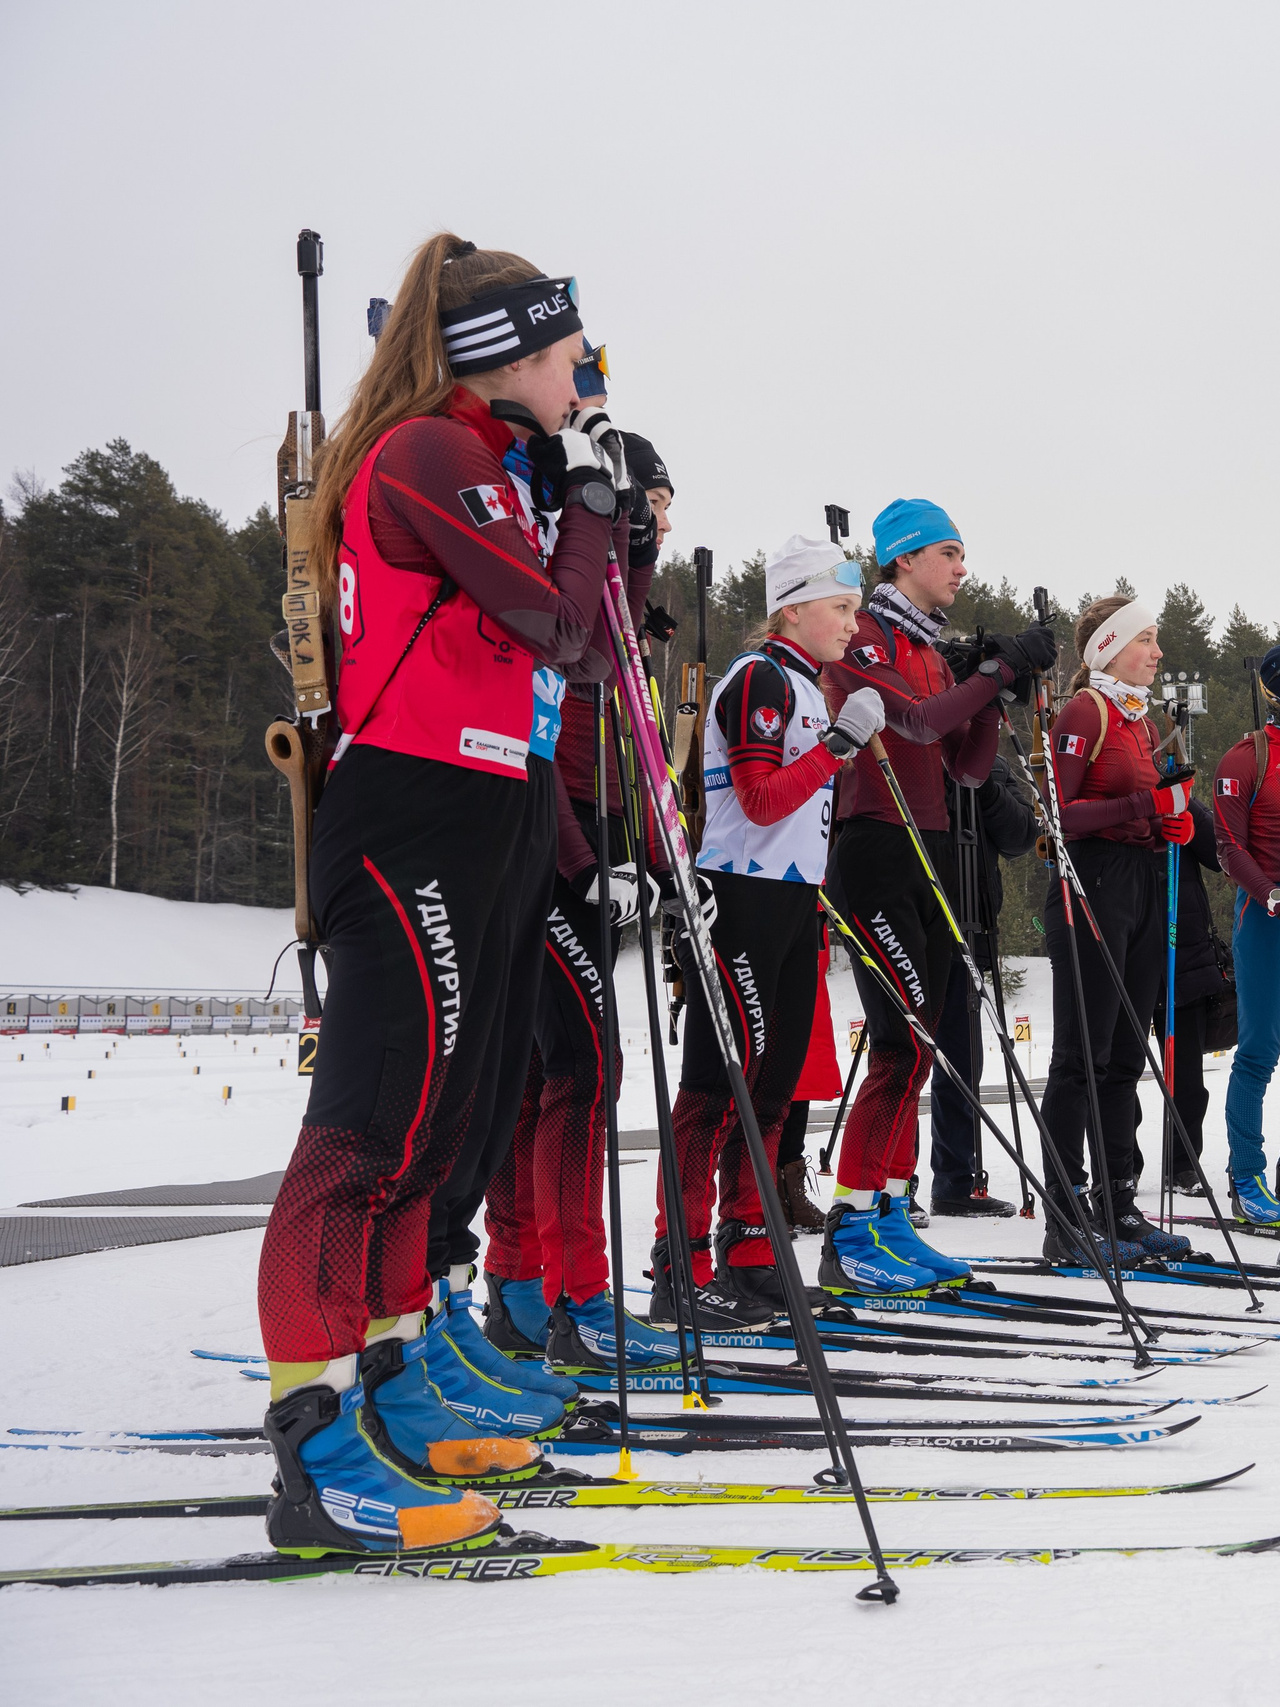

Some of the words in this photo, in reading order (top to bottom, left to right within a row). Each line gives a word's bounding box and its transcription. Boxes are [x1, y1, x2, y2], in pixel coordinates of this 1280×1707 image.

[527, 293, 569, 325] RUS
[631, 530, 654, 546] EKI
[886, 531, 921, 551] NORDSKI
[415, 879, 461, 1056] УДМУРТИЯ
[547, 906, 604, 1017] УДМУРТ
[871, 911, 925, 1007] УДМУРТИЯ
[733, 951, 765, 1056] УДМУРТИЯ
[1016, 1024, 1030, 1040] 21
[1239, 1194, 1279, 1219] SPINE
[840, 1255, 917, 1287] SPINE
[694, 1286, 738, 1310] TISA
[864, 1298, 926, 1311] salomon
[443, 1397, 543, 1429] PINE
[889, 1436, 1012, 1447] salomon
[483, 1489, 578, 1508] CHER
[353, 1557, 542, 1579] FISCHER
